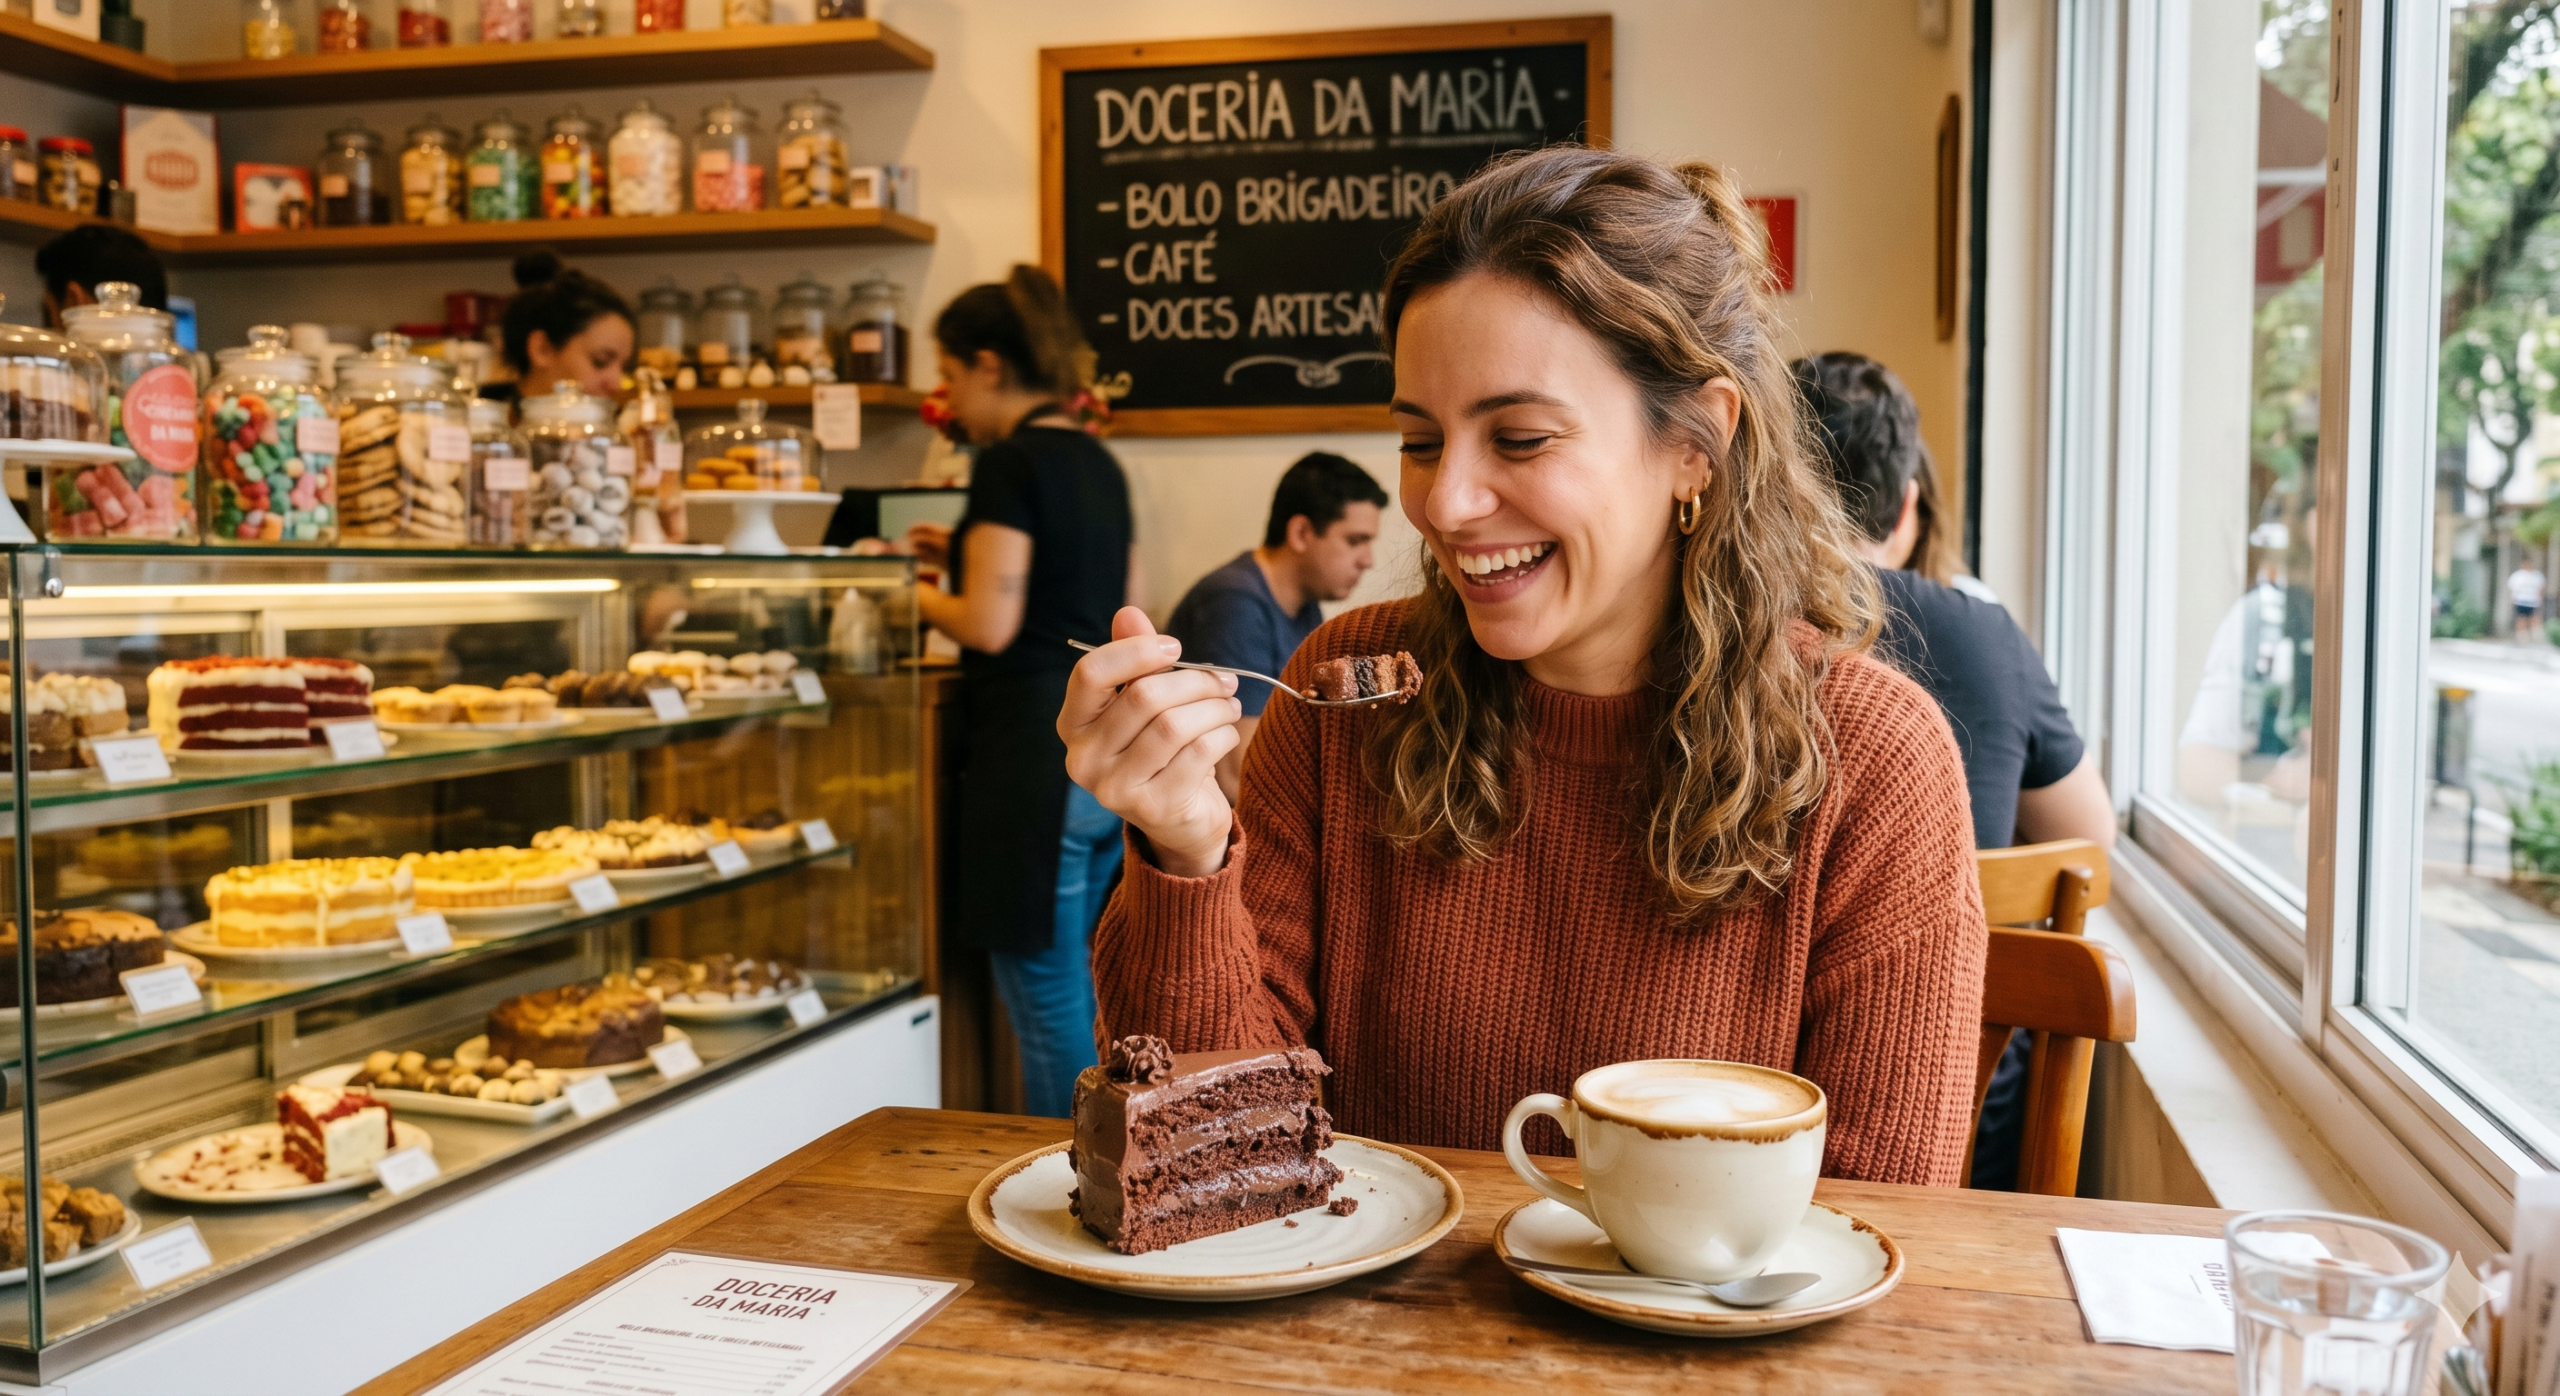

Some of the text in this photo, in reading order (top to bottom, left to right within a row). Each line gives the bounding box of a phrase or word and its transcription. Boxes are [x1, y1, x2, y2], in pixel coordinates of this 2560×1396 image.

[1313, 77, 1373, 136] DA
[1126, 181, 1222, 229] BOLO
[1124, 231, 1217, 284] CAFÉ
[1128, 296, 1239, 341] DOCES
[691, 1294, 729, 1310] DA
[728, 1299, 812, 1320] MARIA
[713, 1277, 838, 1305] DOCERIA
